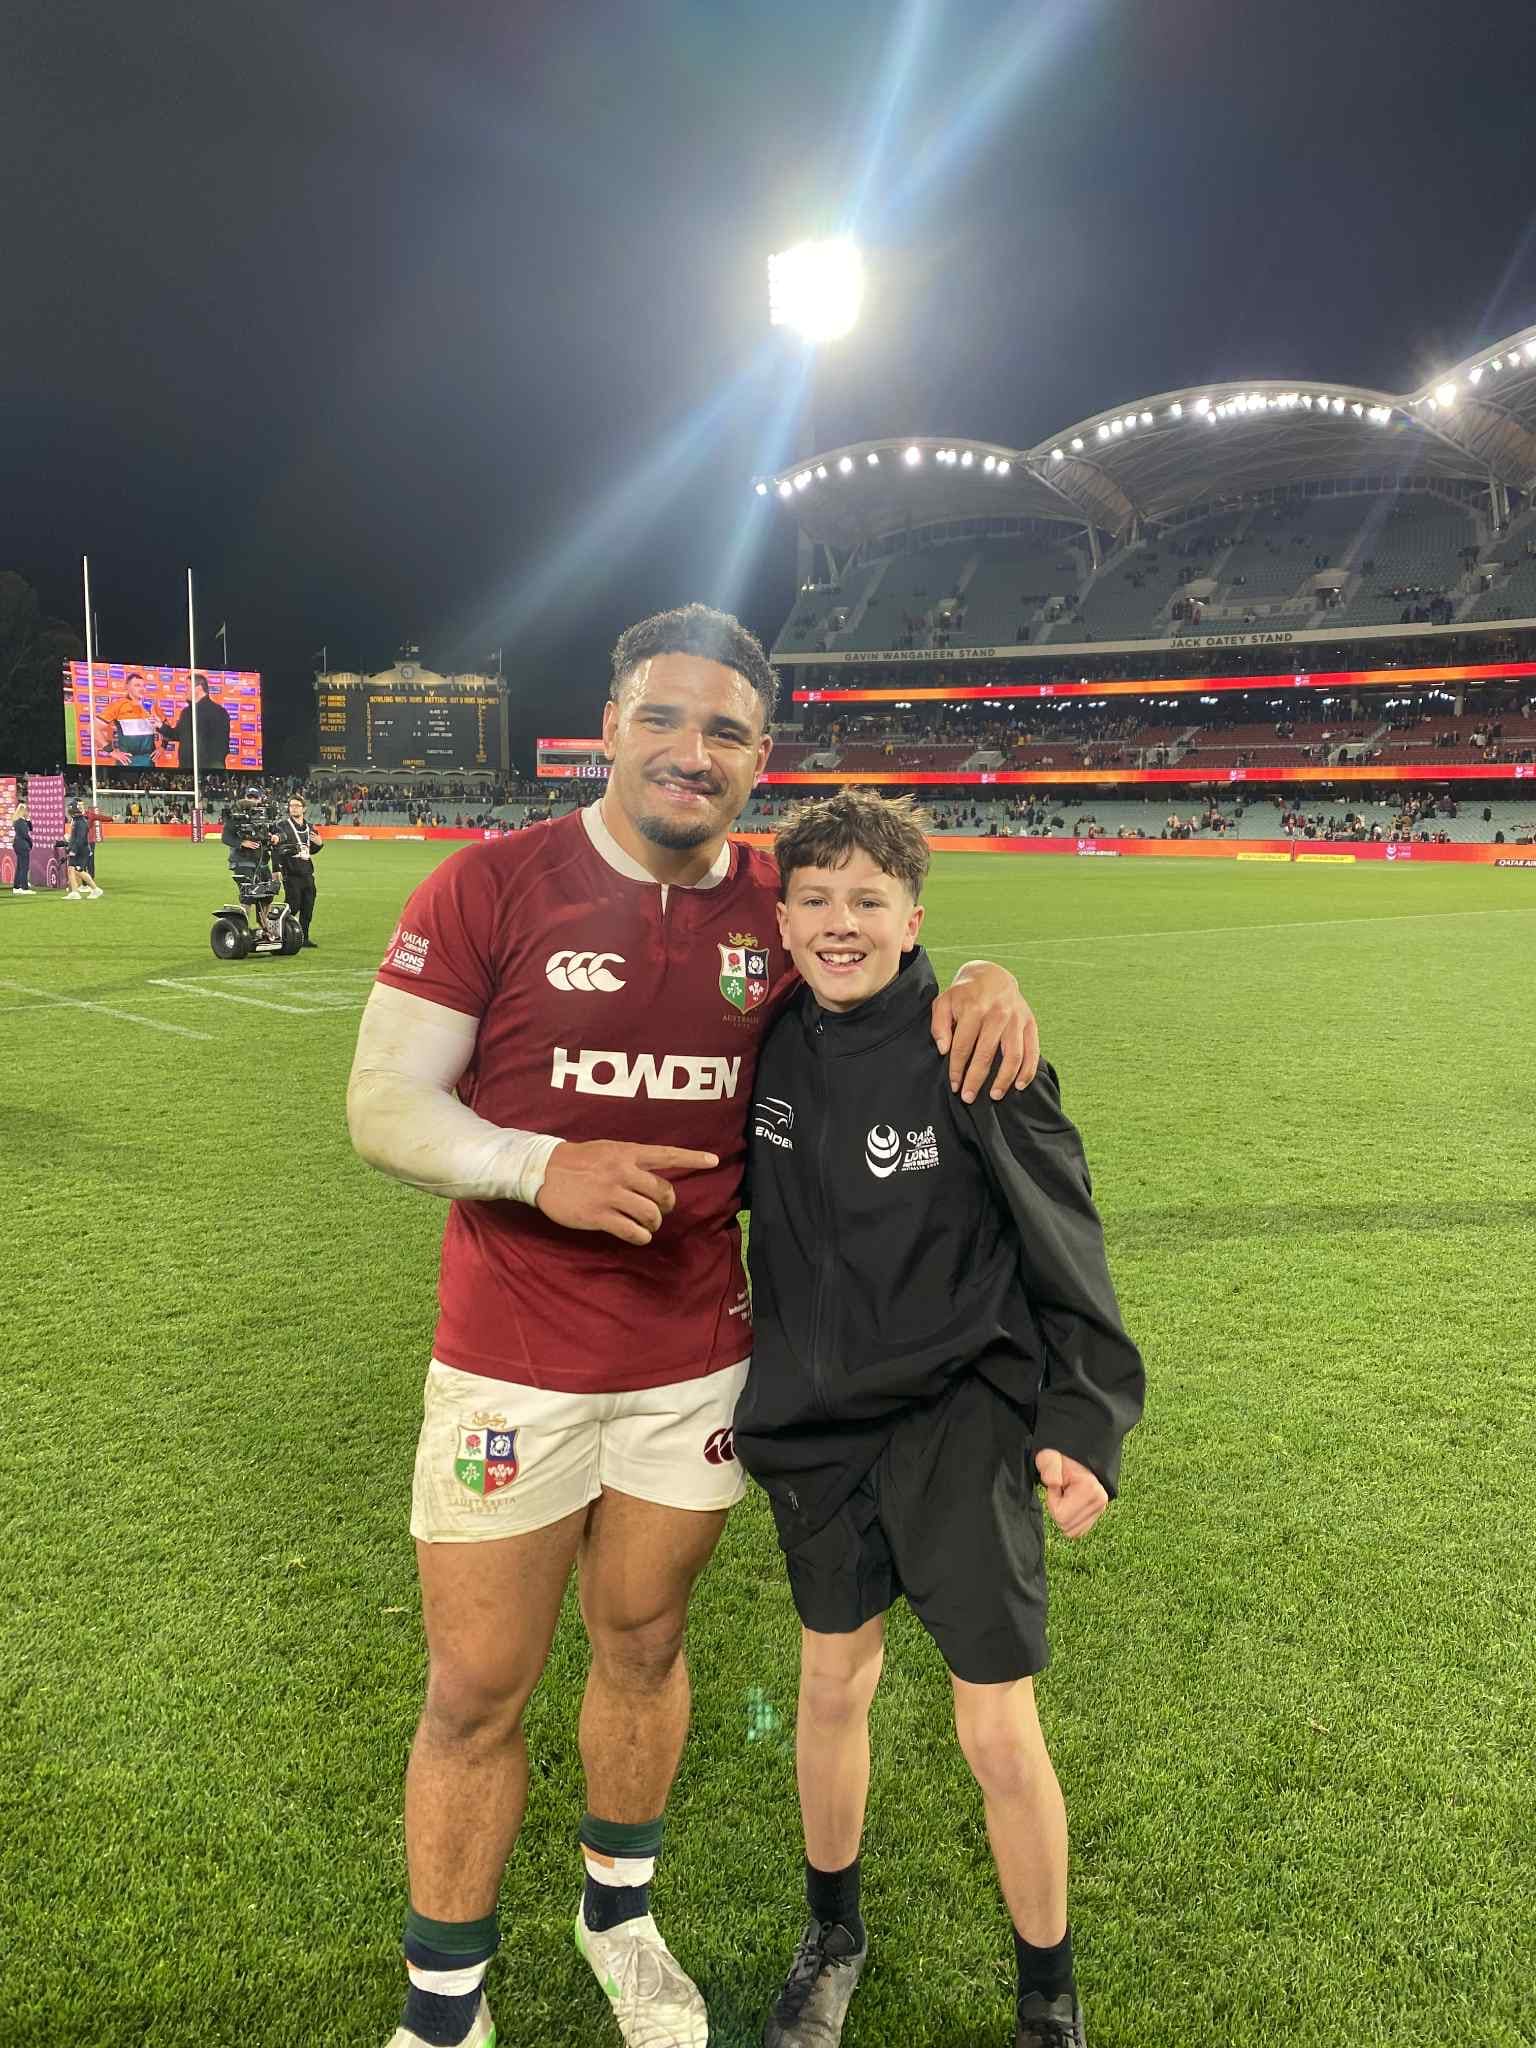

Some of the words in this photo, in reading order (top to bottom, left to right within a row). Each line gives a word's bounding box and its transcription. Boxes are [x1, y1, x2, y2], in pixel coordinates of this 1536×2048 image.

[1170, 638, 1201, 648] JACK
[1206, 635, 1246, 646] OATEY
[1250, 632, 1293, 644] STAND
[844, 652, 880, 661] GAVIN
[959, 647, 996, 658] STAND
[401, 930, 430, 950] QATAR
[394, 948, 425, 969] LIONS
[550, 1046, 742, 1101] HOWDEN
